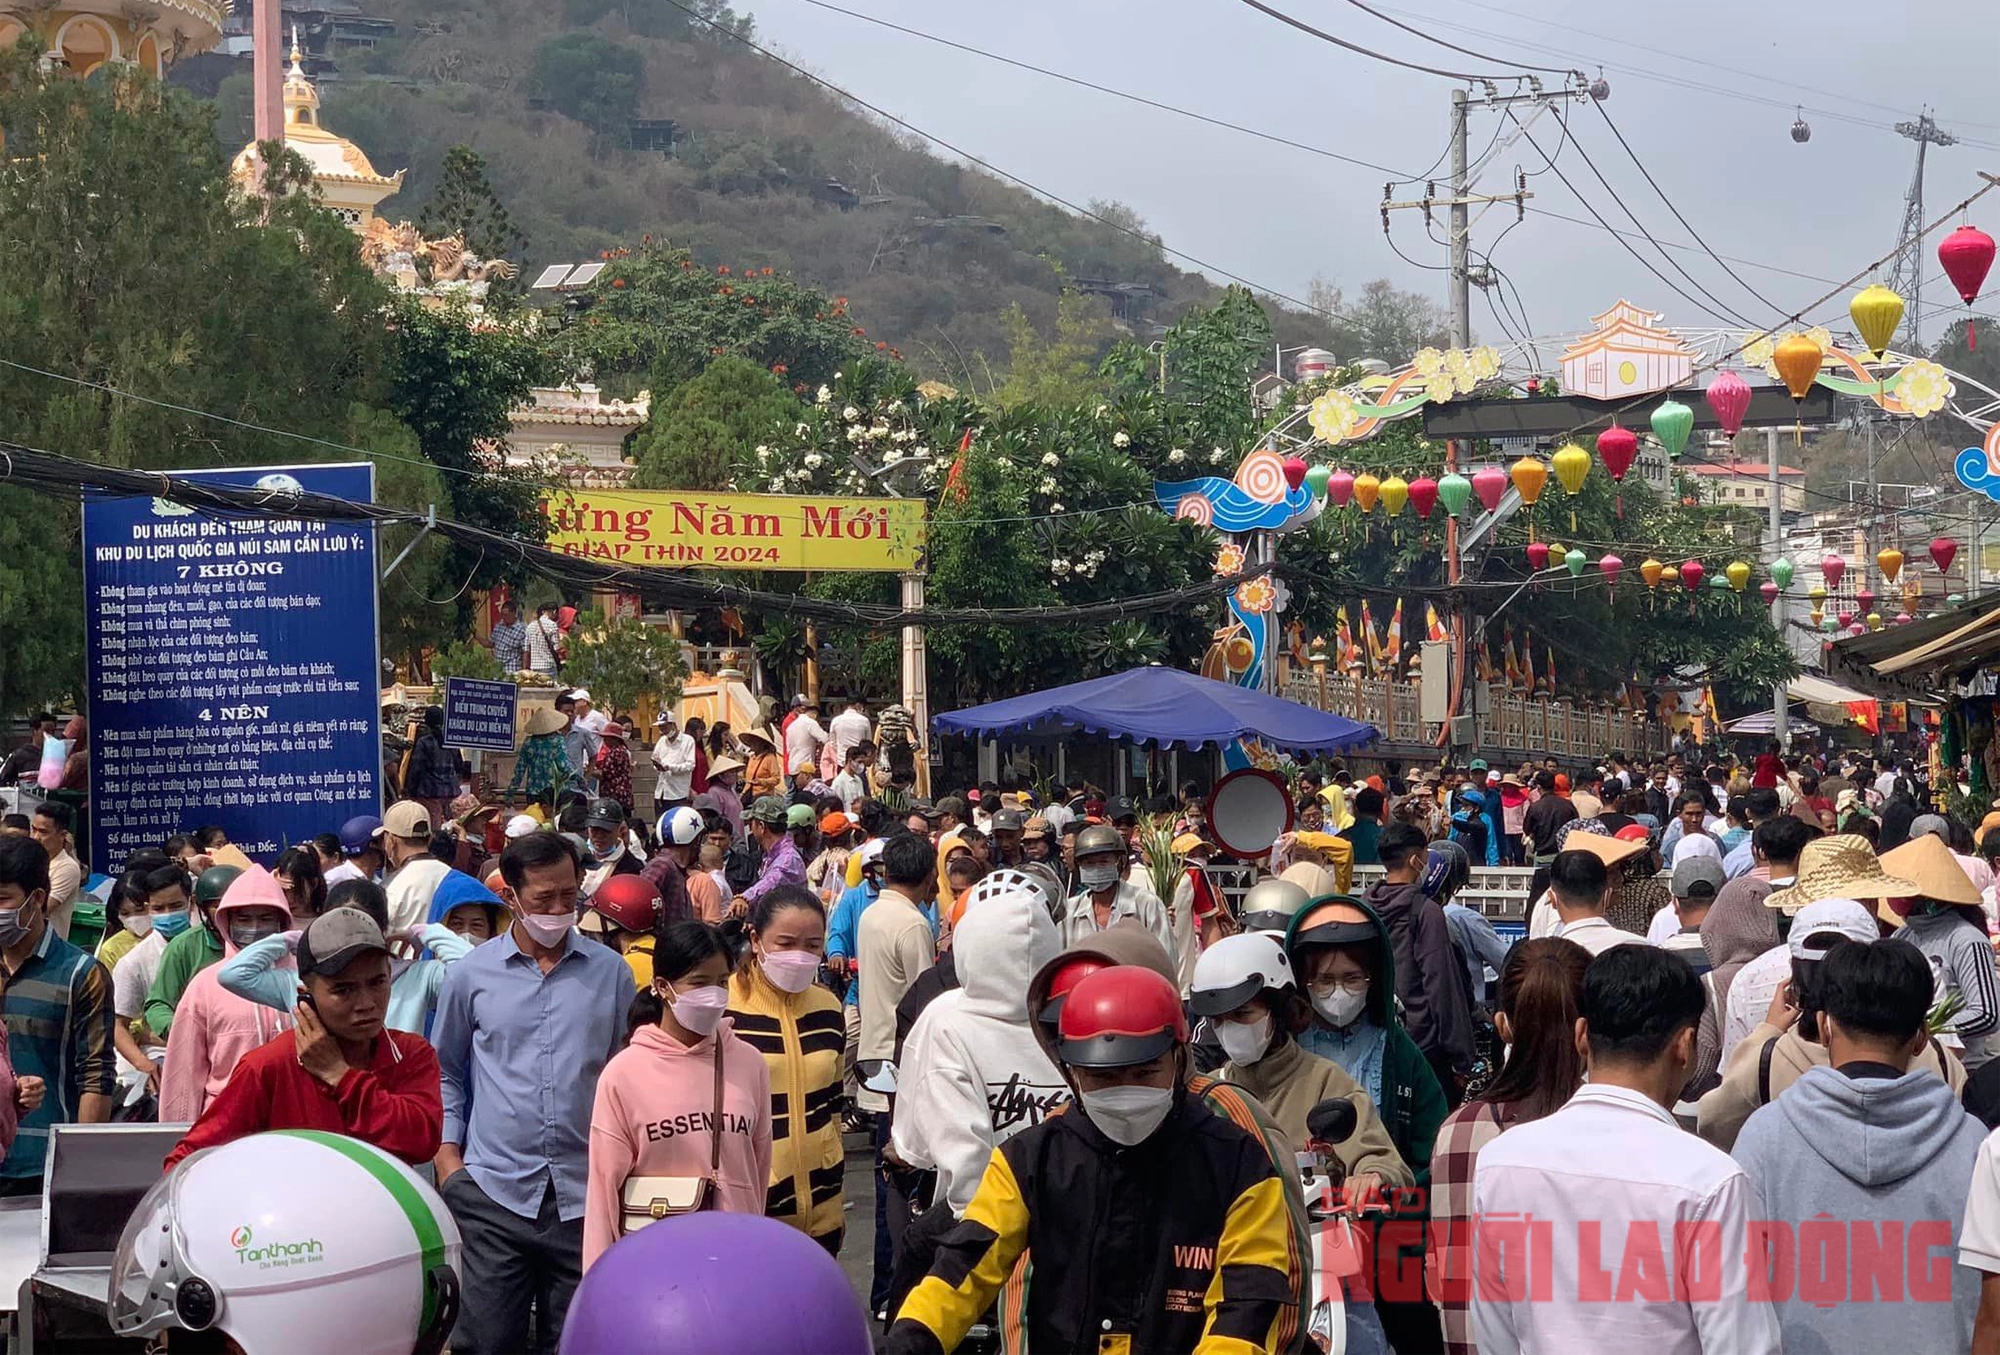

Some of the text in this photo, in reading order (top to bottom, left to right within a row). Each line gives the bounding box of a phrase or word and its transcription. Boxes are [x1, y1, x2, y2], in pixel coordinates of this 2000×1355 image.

[539, 497, 890, 541] ừng Năm Mới
[132, 525, 150, 538] DU
[154, 521, 196, 537] KHÁCH
[268, 520, 301, 534] QUAN
[96, 533, 363, 560] KHU DU LỊCH QUỐC GIA NÚI SAM CẦN LƯU Ý:
[714, 546, 780, 562] 2024
[176, 560, 284, 579] 7 KHÔNG
[100, 585, 124, 599] Không
[101, 602, 125, 616] Không
[101, 619, 125, 633] Không
[102, 637, 125, 651] Không
[102, 654, 126, 668] Không
[102, 672, 126, 685] Không
[102, 689, 126, 702] Không
[198, 704, 270, 720] 4 NÊN
[121, 832, 140, 845] điện
[258, 839, 277, 852] Đốc:
[1174, 1245, 1213, 1270] WIN
